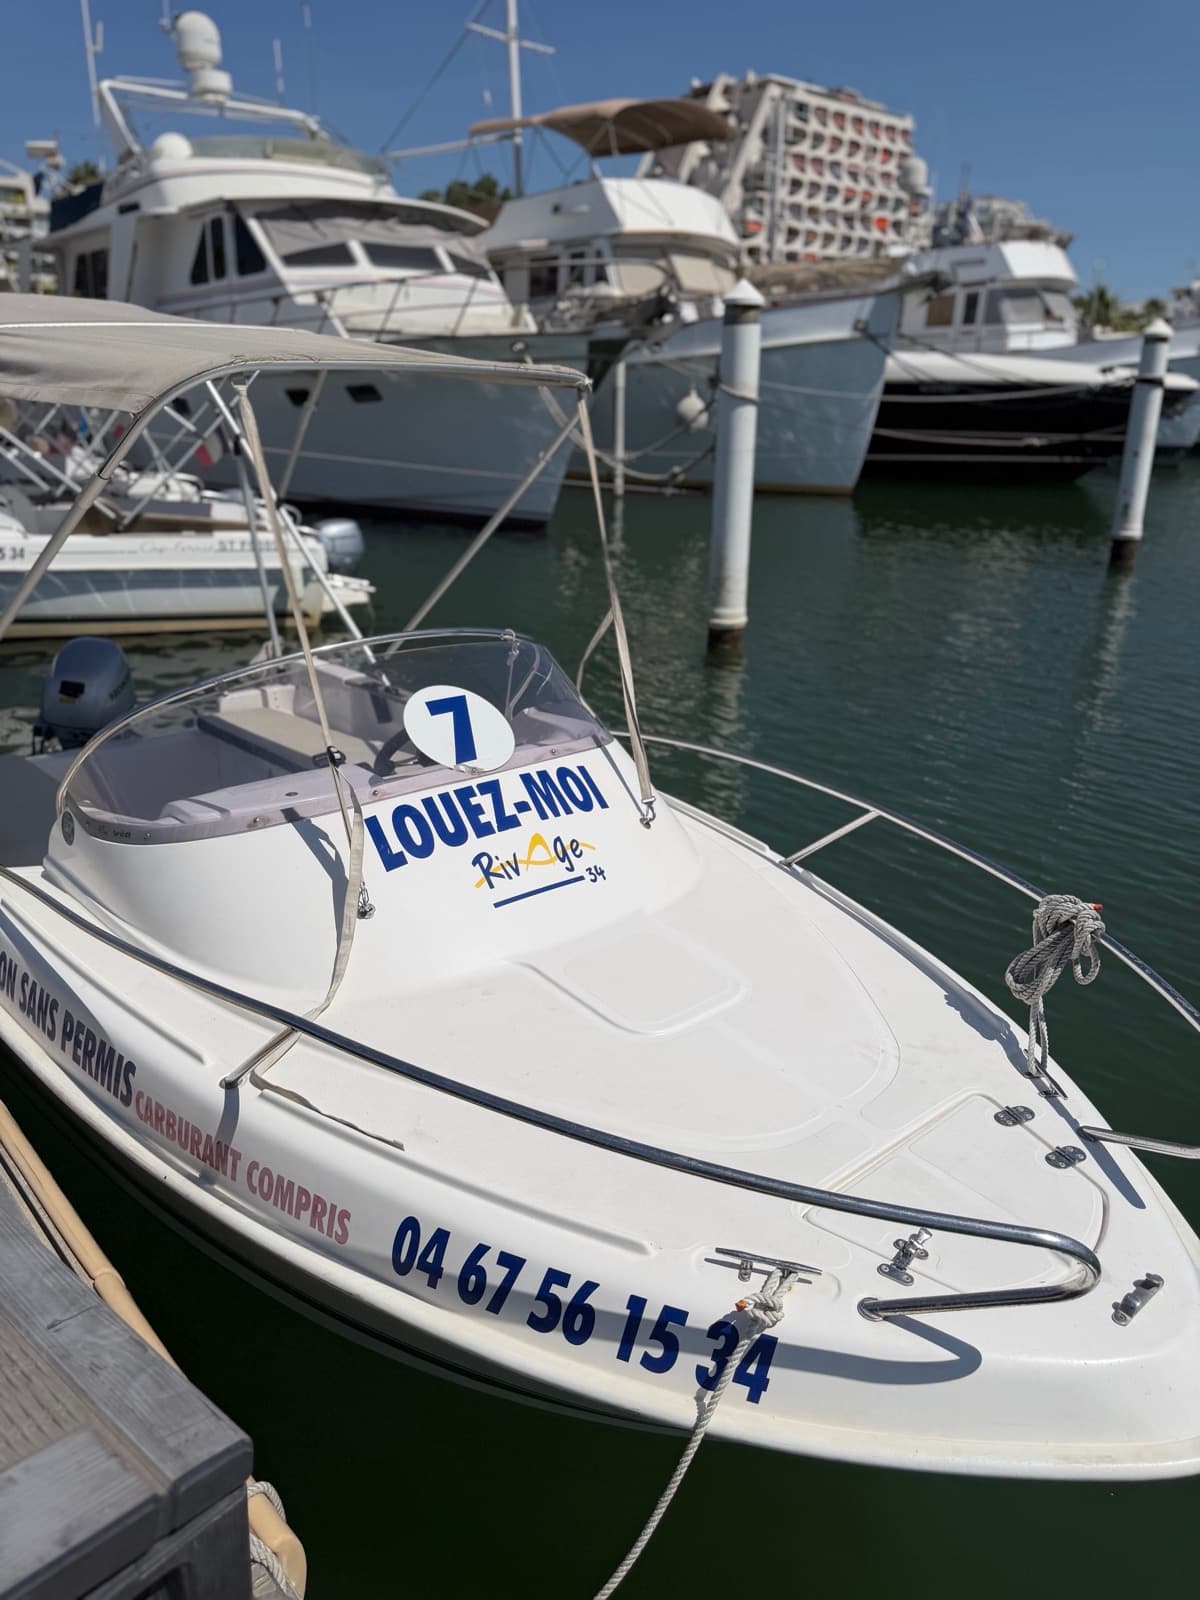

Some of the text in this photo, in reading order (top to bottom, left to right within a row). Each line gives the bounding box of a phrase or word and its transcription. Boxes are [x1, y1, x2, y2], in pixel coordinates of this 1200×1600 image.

[425, 695, 477, 764] 7
[364, 765, 609, 872] LOUEZ-MOI
[585, 865, 606, 883] 34
[19, 972, 59, 1041] SANS
[61, 1009, 136, 1108] PERMIS
[135, 1090, 352, 1245] CARBURANT COMPRIS
[392, 1216, 779, 1404] 04 67 56 15 34
